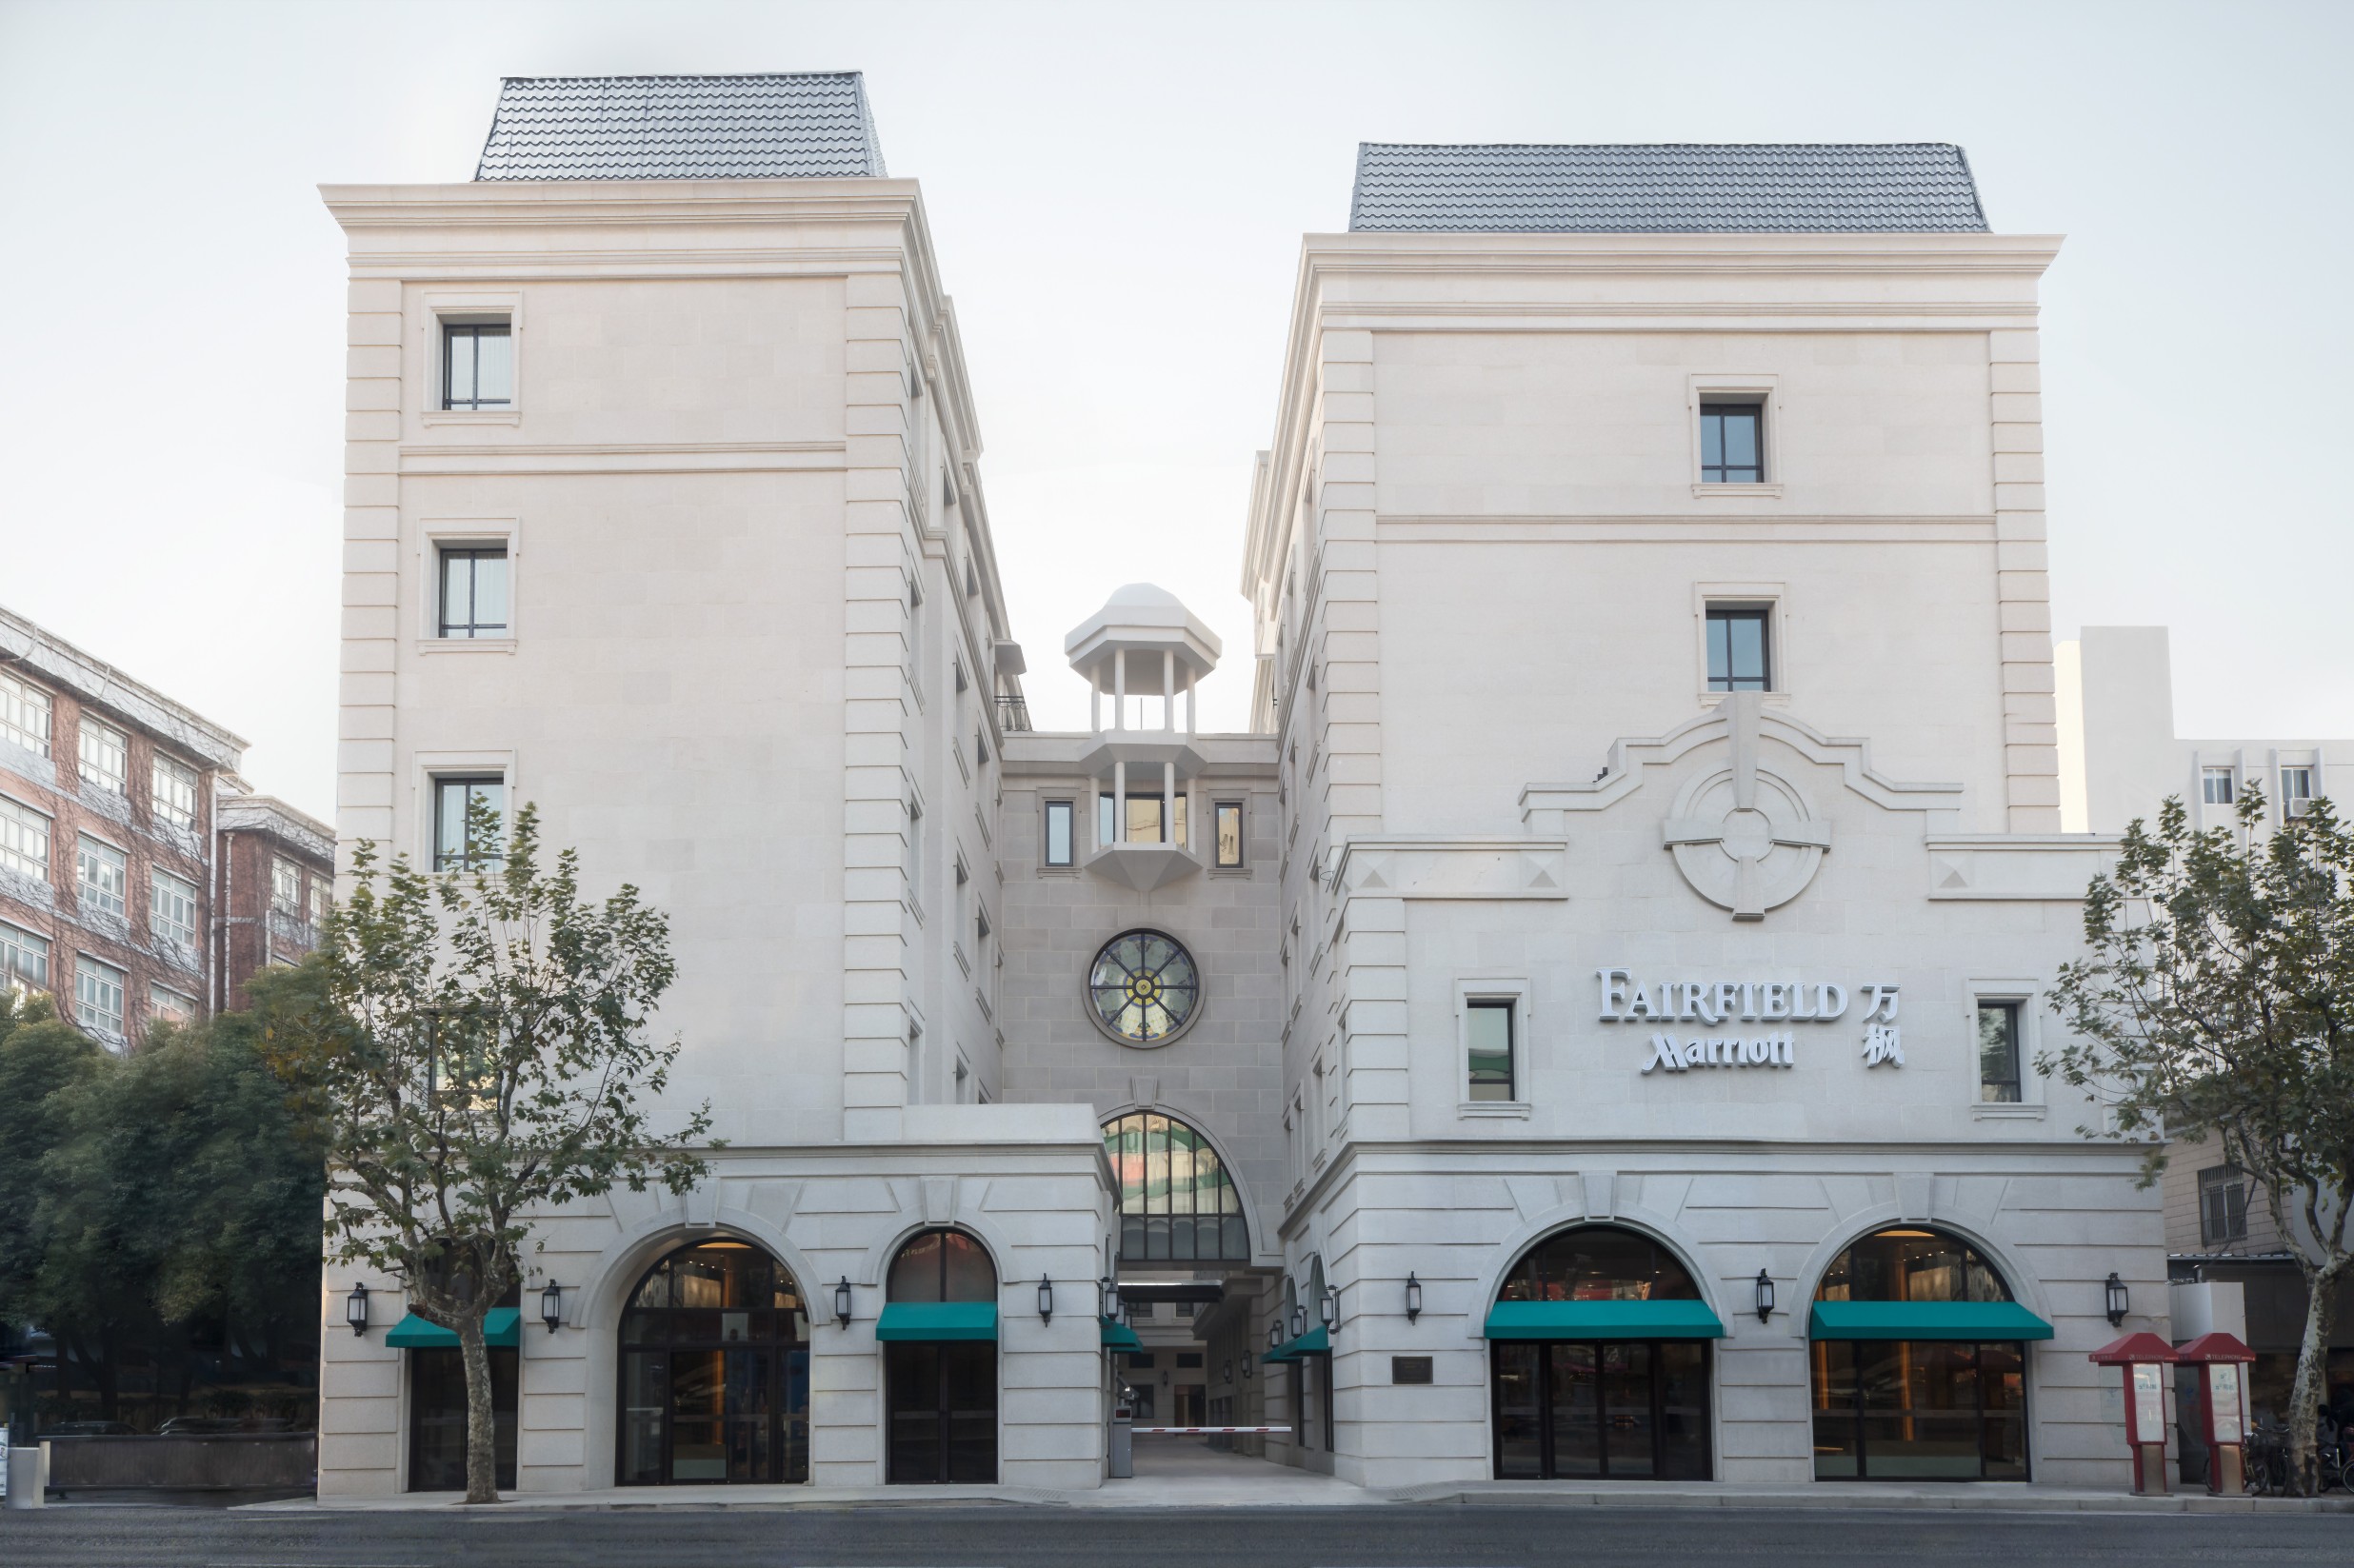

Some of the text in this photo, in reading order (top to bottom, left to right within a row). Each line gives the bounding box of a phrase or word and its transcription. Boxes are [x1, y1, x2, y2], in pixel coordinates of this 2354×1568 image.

[1596, 967, 1848, 1026] FAIRFIELD
[1860, 982, 1905, 1068] 万枫
[1641, 1031, 1794, 1074] Marriott
